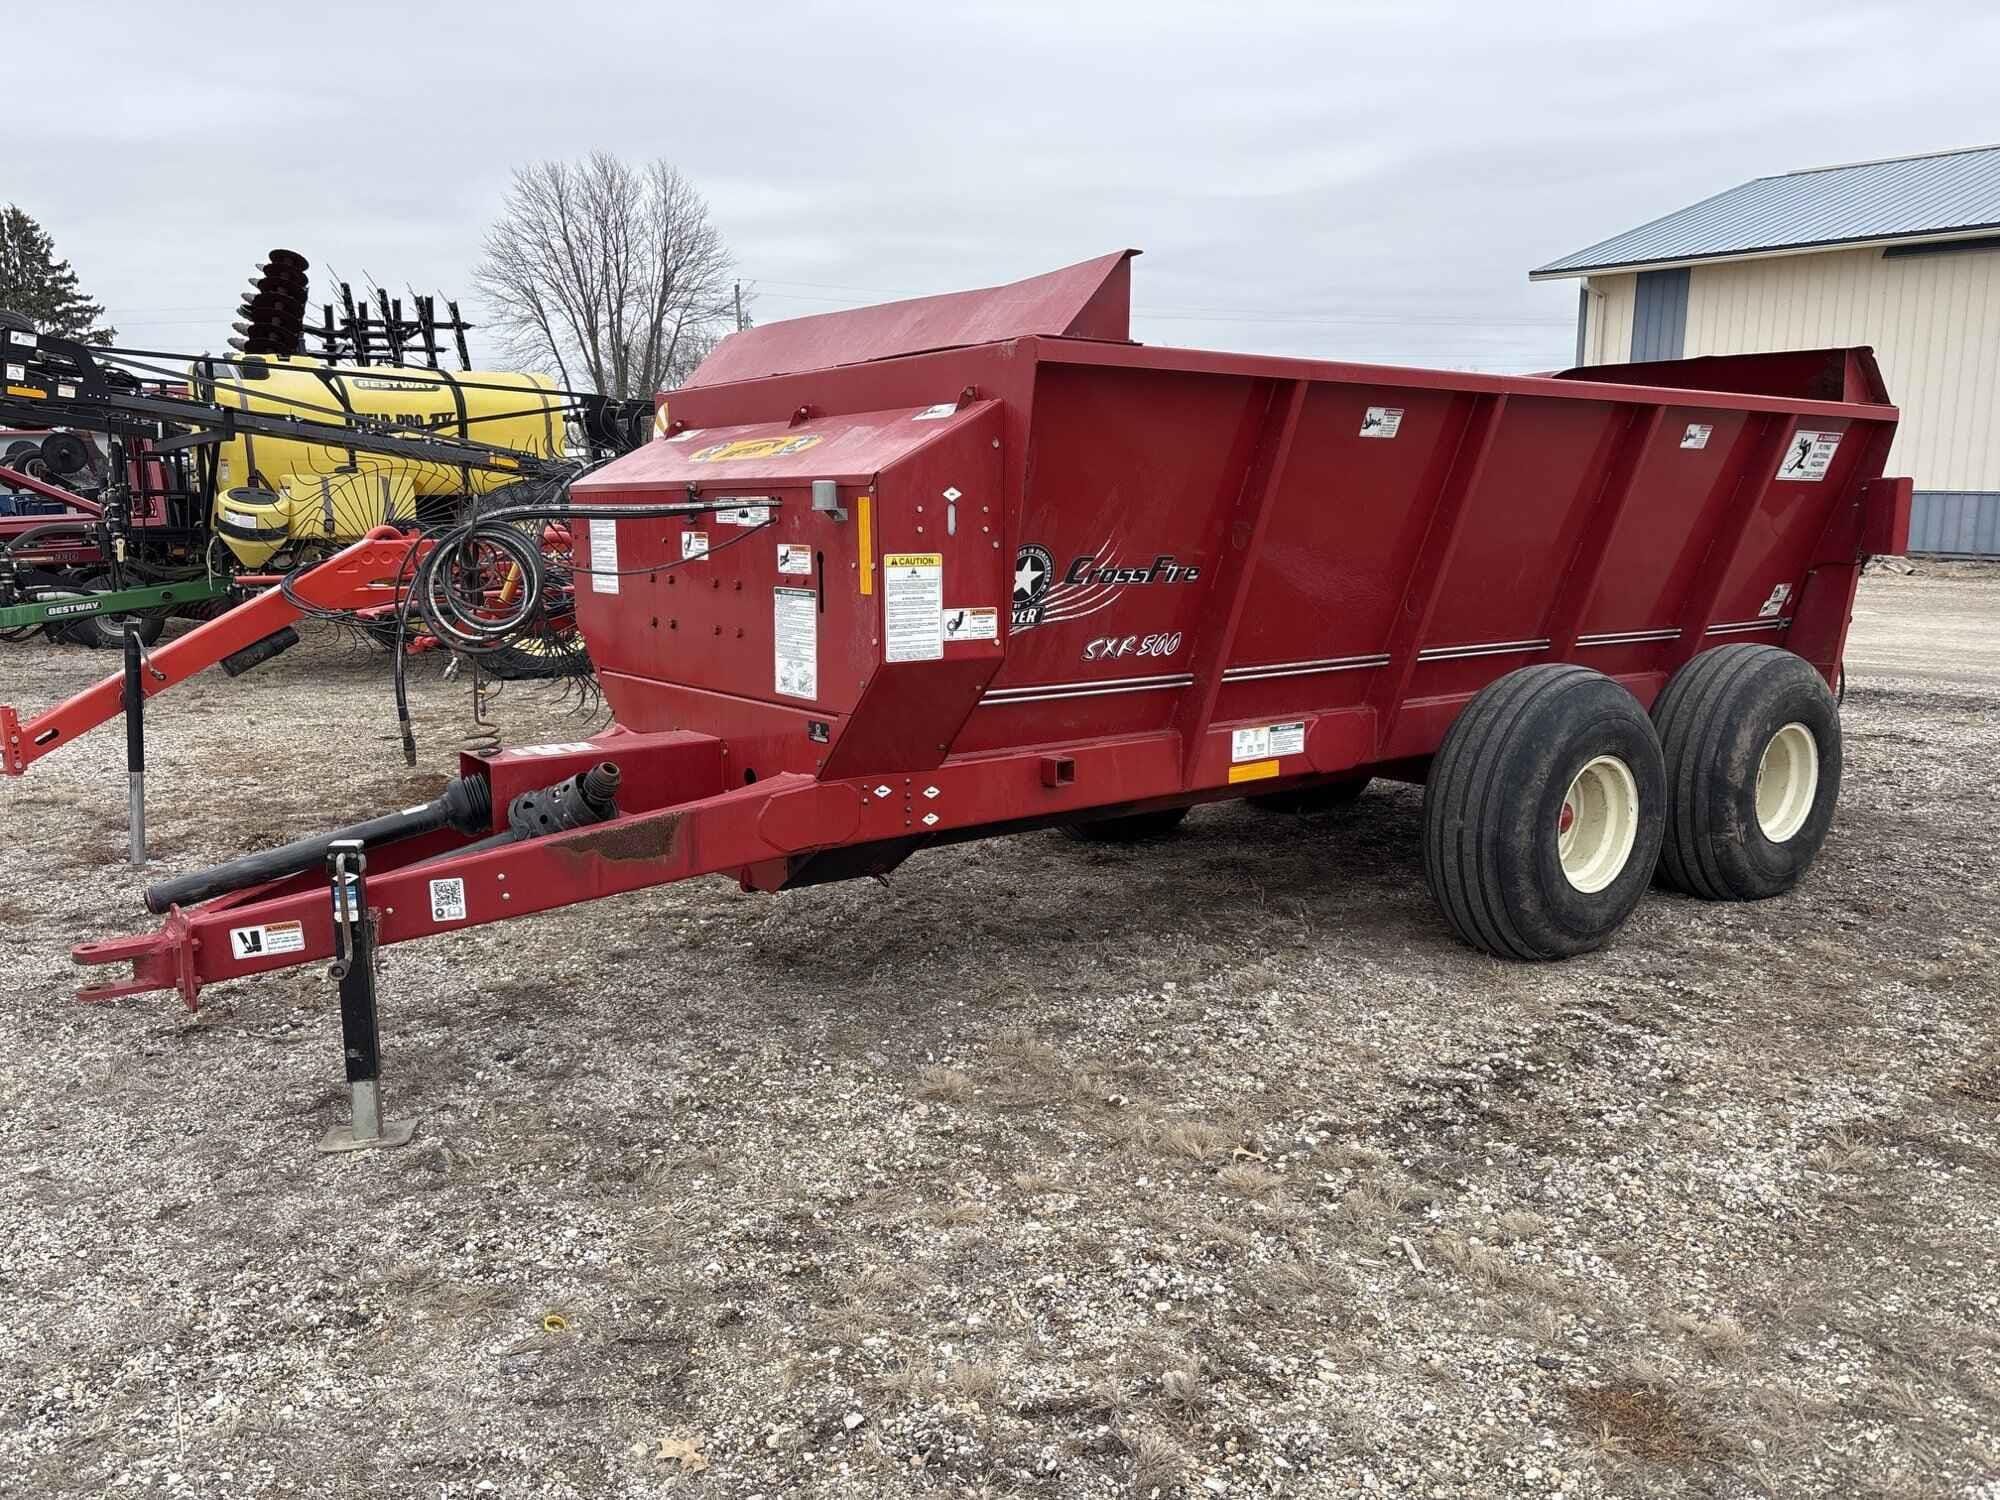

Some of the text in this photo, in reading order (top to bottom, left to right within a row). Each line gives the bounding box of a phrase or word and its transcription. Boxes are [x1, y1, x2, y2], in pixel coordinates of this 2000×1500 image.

[358, 380, 434, 389] BESTWAY
[899, 557, 935, 566] CAUTION
[1064, 555, 1200, 584] CrossFire
[48, 601, 99, 615] BESTWAY
[1011, 608, 1038, 623] YER
[1082, 631, 1182, 661] SXR 500
